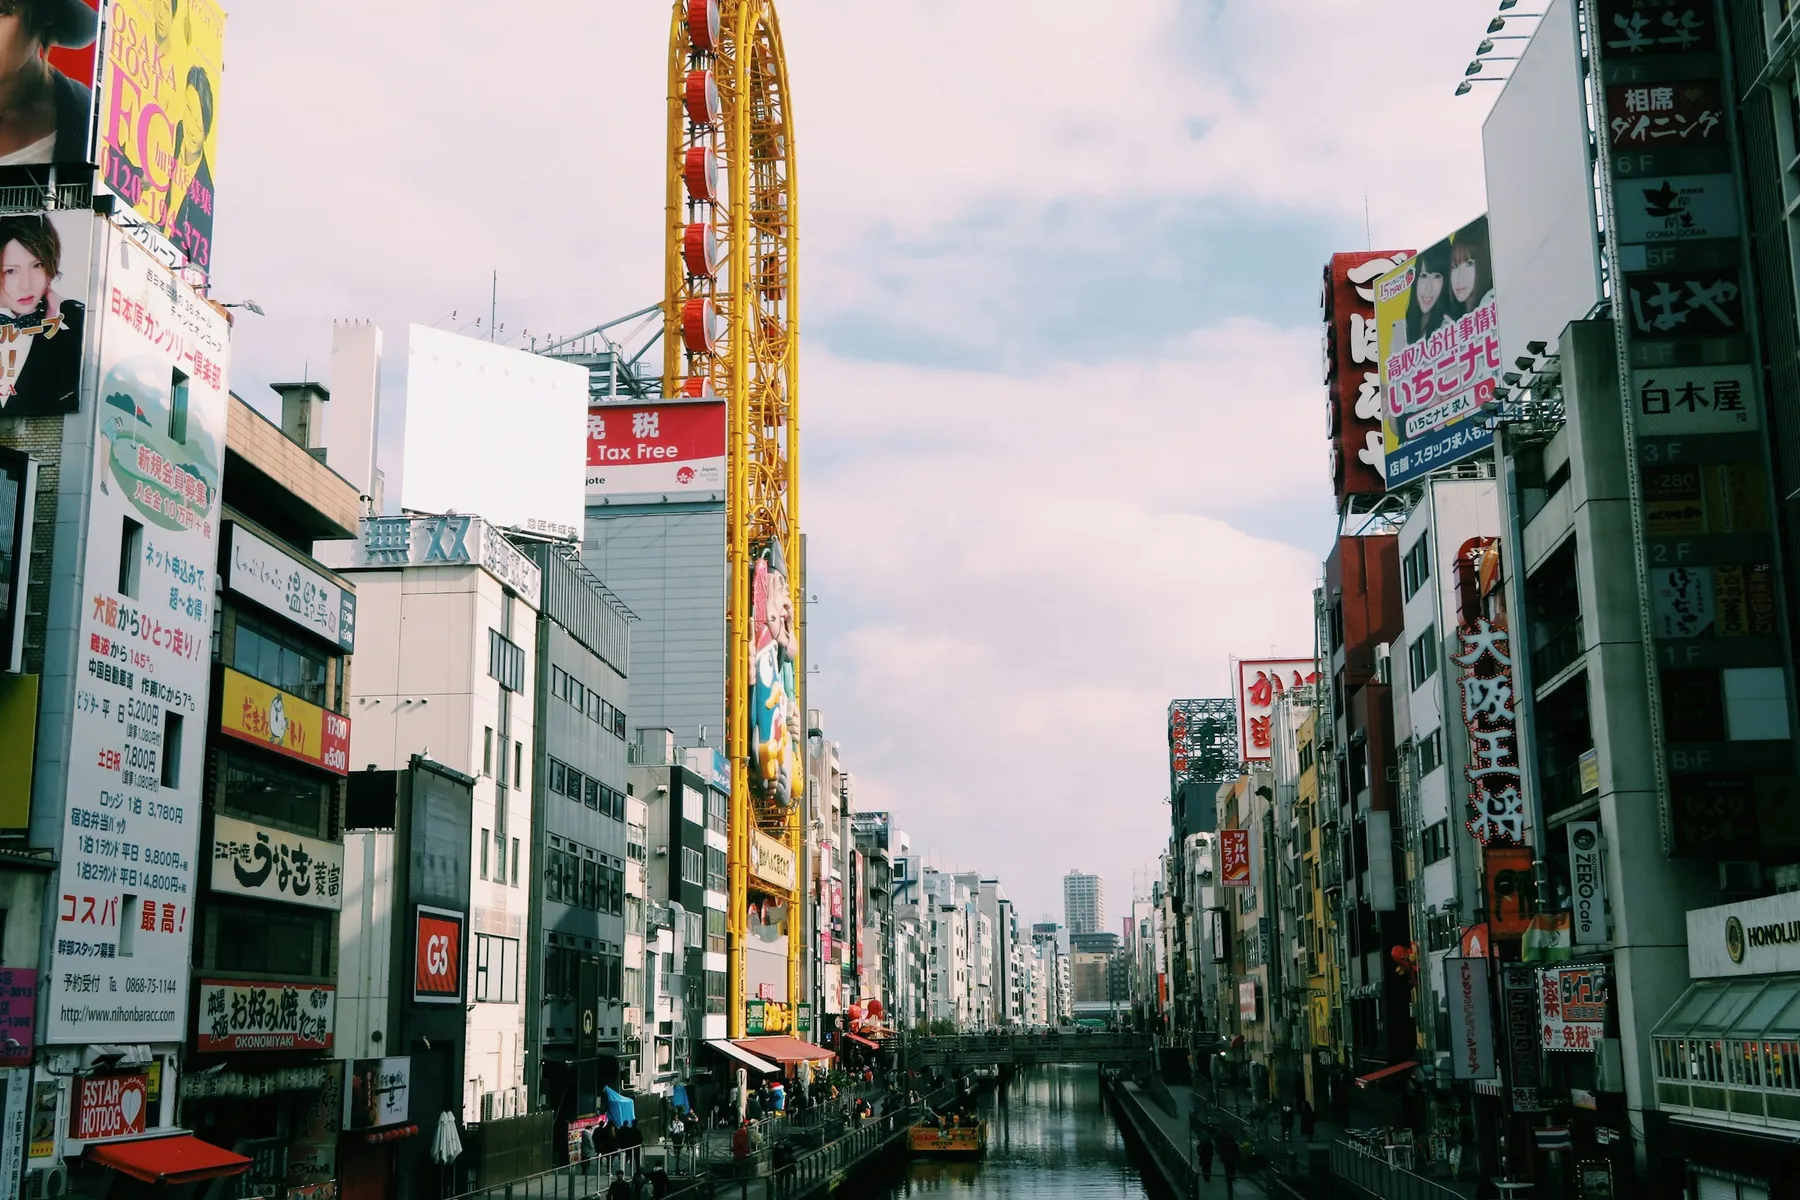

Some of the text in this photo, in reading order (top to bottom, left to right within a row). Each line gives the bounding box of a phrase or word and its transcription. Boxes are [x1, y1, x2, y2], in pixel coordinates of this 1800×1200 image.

[112, 2, 177, 92] OSAKA
[1606, 9, 1705, 52] 笑笑
[109, 31, 163, 101] HOST
[1625, 87, 1674, 112] 相席
[103, 61, 175, 192] FC
[1611, 111, 1722, 144] ダイニング
[1617, 155, 1654, 173] 6F
[101, 147, 209, 266] 0120-194-373
[1648, 248, 1676, 266] 5F
[111, 286, 222, 392] 日本原カンツリー倶楽部
[1641, 379, 1746, 414] 白木屋
[587, 411, 659, 440] 免税
[1409, 395, 1470, 434] いちごナビ 求人
[598, 443, 678, 461] Tax Free
[1644, 442, 1681, 462] 3F
[137, 444, 216, 511] 新規会員募集!
[365, 517, 471, 563] 無双
[1653, 543, 1691, 562] 2F
[92, 592, 202, 662] 大阪からひとつ走り!
[88, 657, 134, 691] 中国自動車道
[127, 697, 159, 727] 5,200円
[327, 714, 347, 740] 17:00
[1450, 616, 1525, 847] 大阪王将
[98, 743, 157, 774] 土日祝 7,800円
[100, 790, 124, 810] ロッジ
[148, 801, 183, 825] 3,780円
[121, 844, 139, 862] 平日
[234, 831, 313, 897] うなぎ
[1223, 838, 1234, 873] ドラッグ
[1233, 832, 1247, 865] ツルハ
[120, 867, 137, 887] 平日
[1576, 853, 1594, 899] ZERO
[61, 893, 187, 934] コスパ 最高!
[57, 939, 116, 959] 幹部スタッフ募集
[427, 934, 449, 976] G3
[63, 973, 100, 993] 予約受付
[125, 977, 176, 994] 0868-75-1144
[1542, 972, 1560, 1018] 薬
[60, 1004, 176, 1026] http://www.nihonbaracc.com
[207, 988, 226, 1016] 本場
[230, 985, 299, 1031] お好み焼
[210, 1013, 229, 1043] 大阪
[234, 1035, 295, 1049] OKONOMIYAKI
[1562, 1024, 1590, 1048] 免税
[84, 1079, 120, 1107] 5STAR
[81, 1106, 122, 1134] HOTDOG
